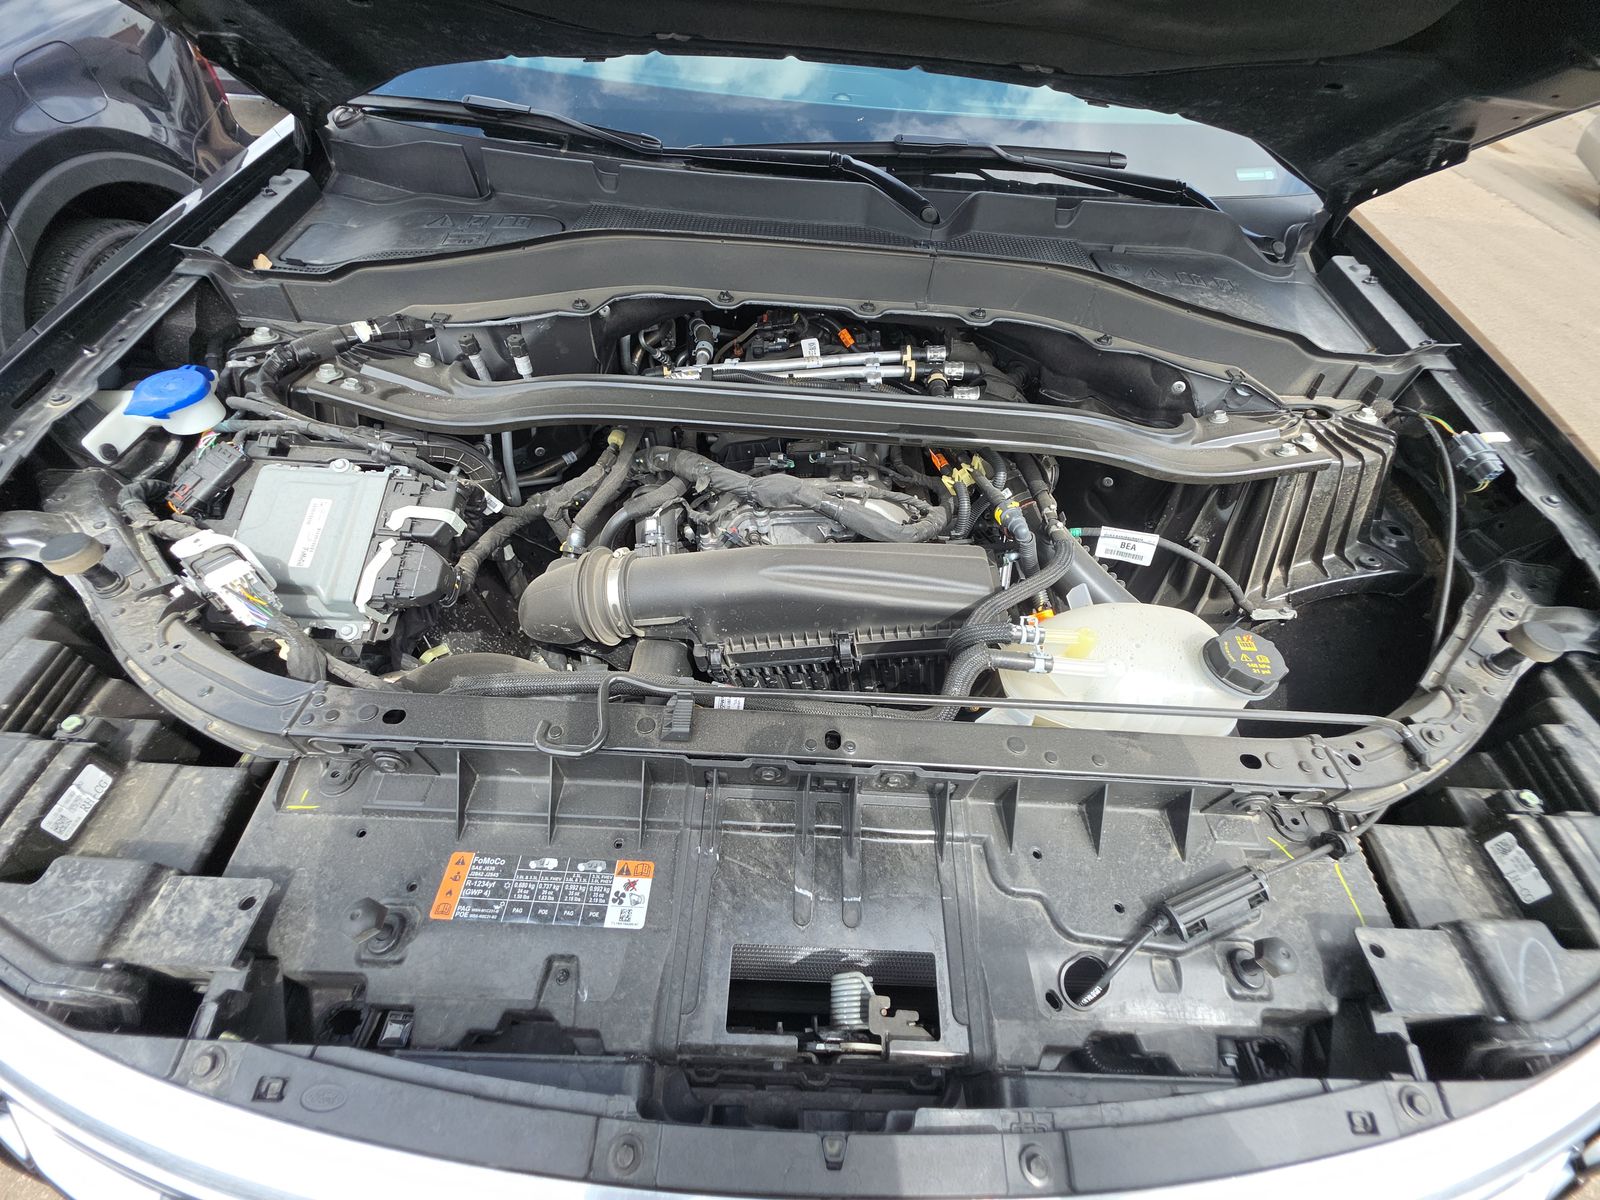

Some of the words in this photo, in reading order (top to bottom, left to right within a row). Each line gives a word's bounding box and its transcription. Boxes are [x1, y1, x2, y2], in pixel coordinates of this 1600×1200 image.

[1120, 541, 1137, 551] BEA
[472, 856, 506, 866] FoMoCo
[465, 880, 496, 890] R-1234yf
[603, 886, 611, 894] kg
[462, 889, 483, 897] (GWP
[483, 889, 491, 898] 4)
